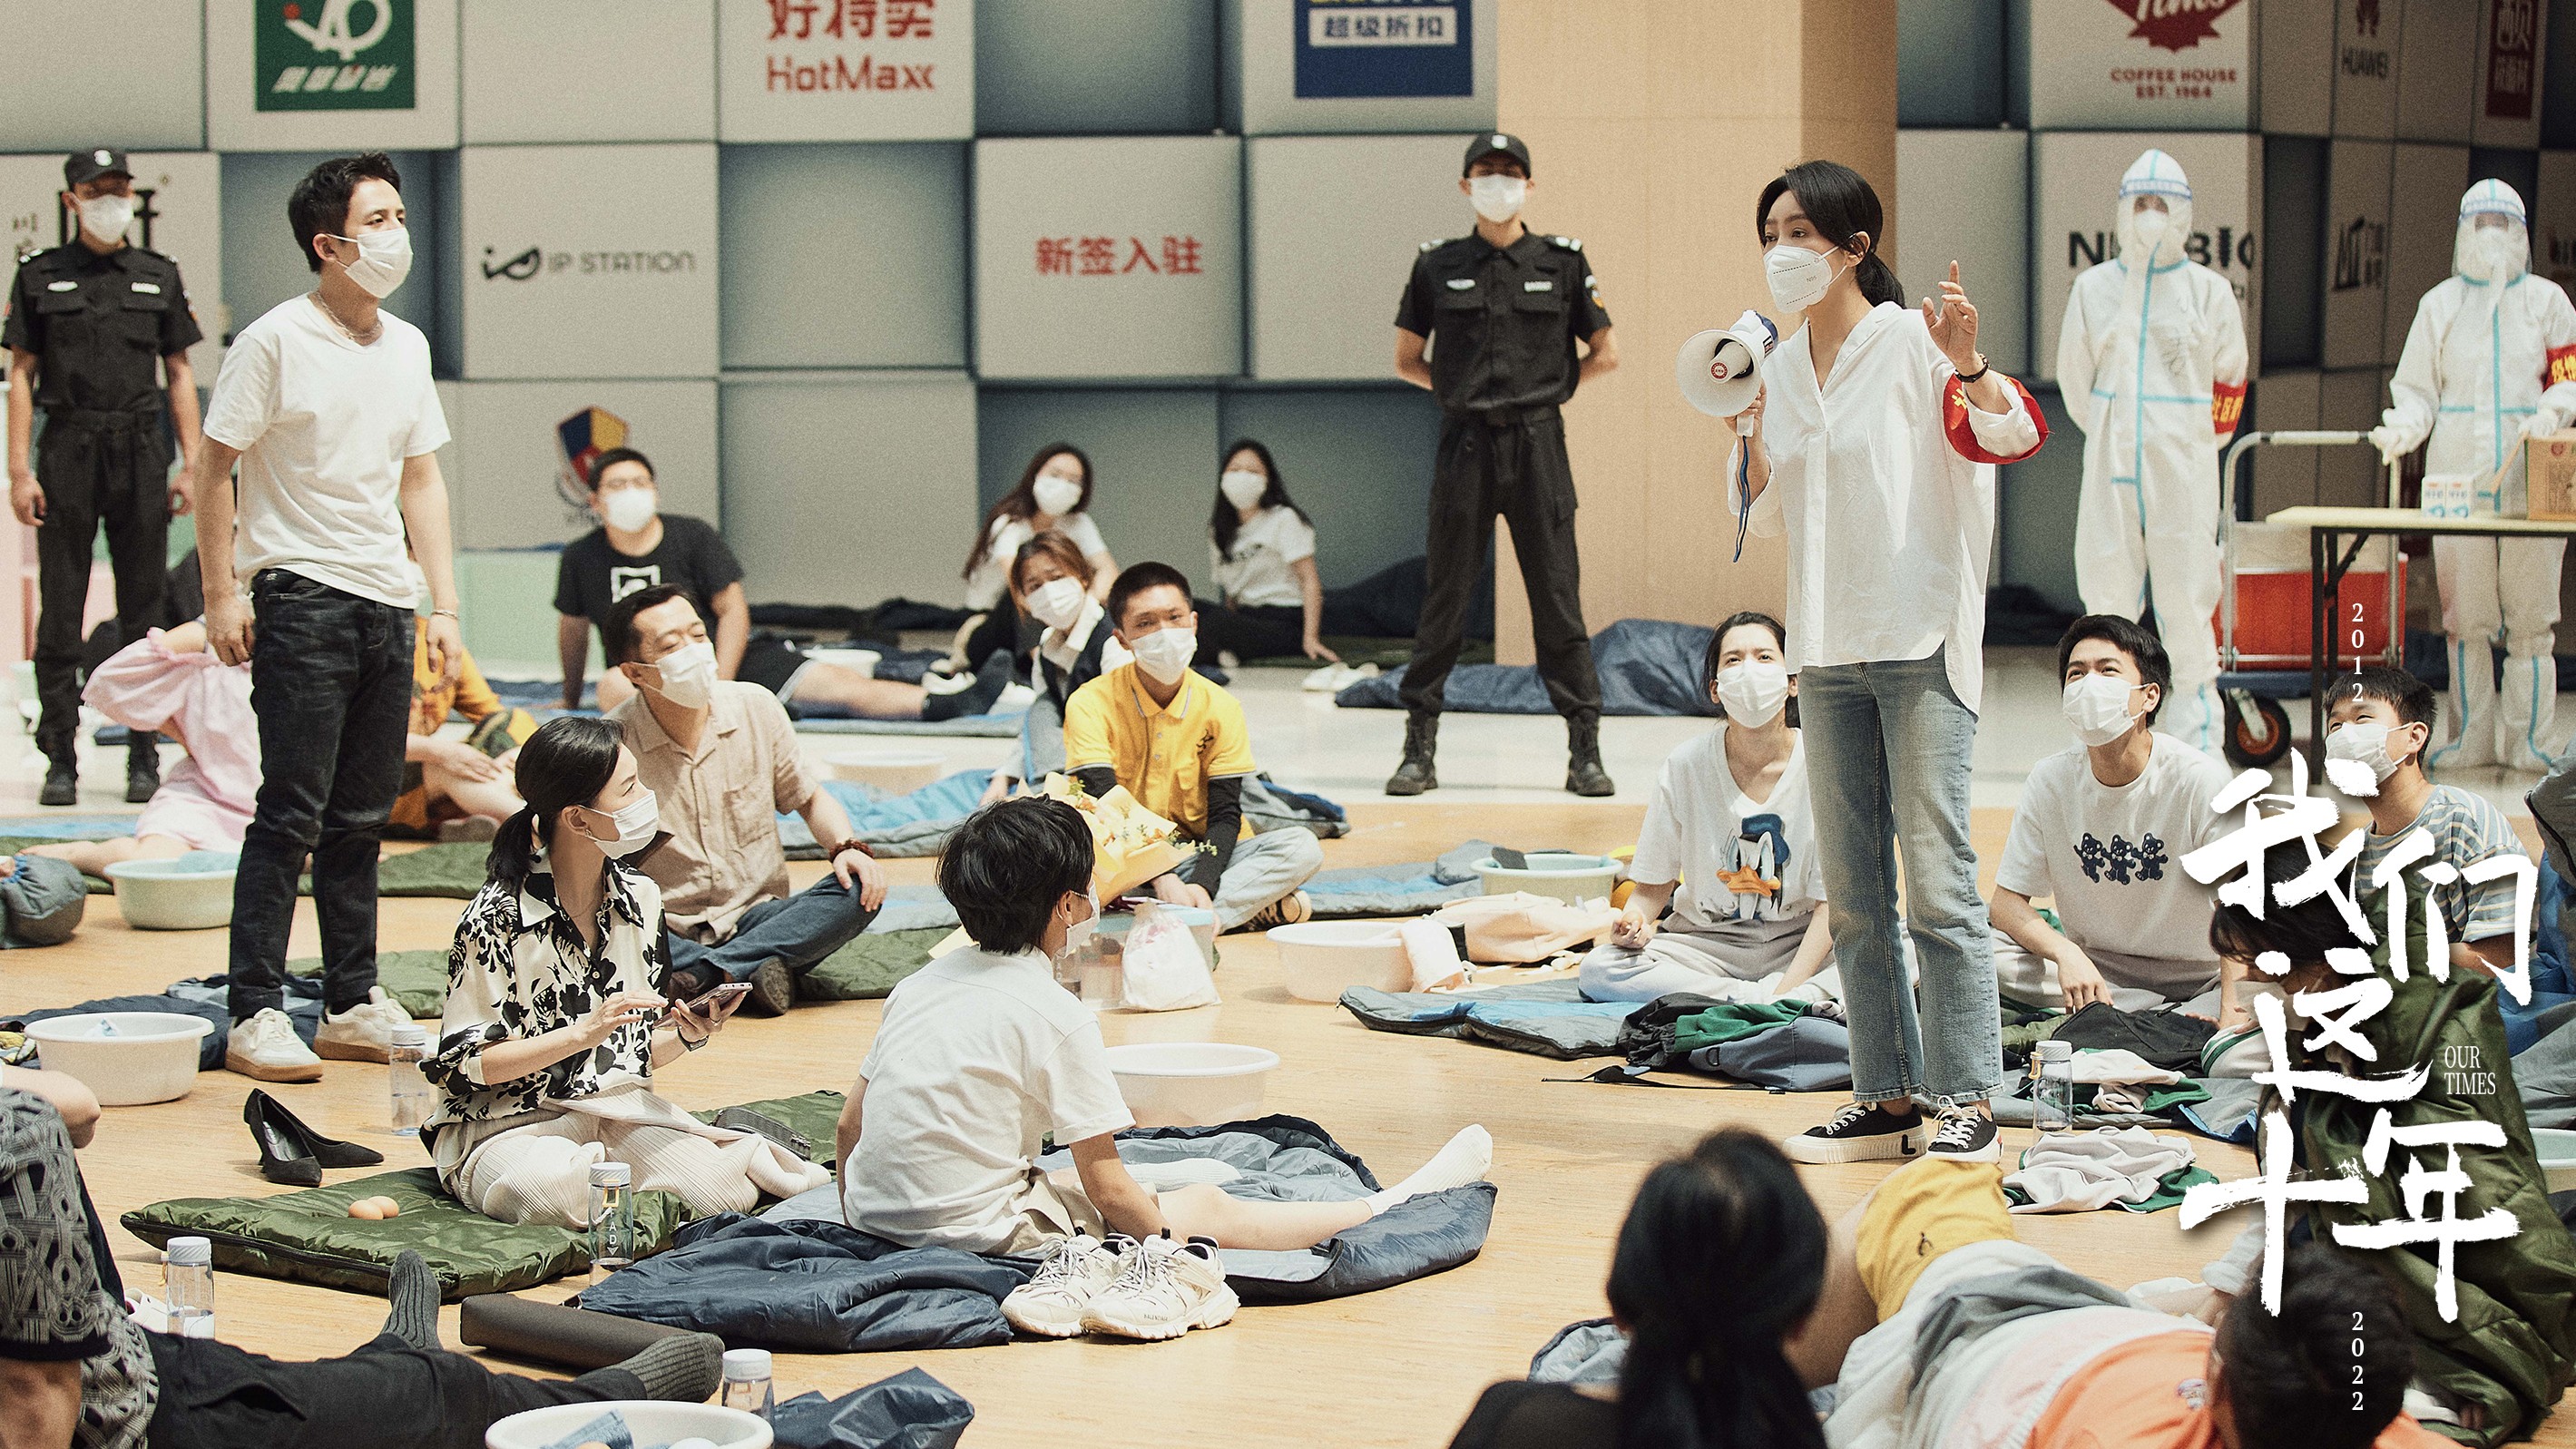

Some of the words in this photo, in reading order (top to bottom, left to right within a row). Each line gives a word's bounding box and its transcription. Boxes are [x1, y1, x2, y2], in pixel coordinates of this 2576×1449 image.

[2111, 67, 2176, 83] COFFEE
[2180, 67, 2238, 83] HOUSE
[1036, 236, 1203, 275] 新签入驻
